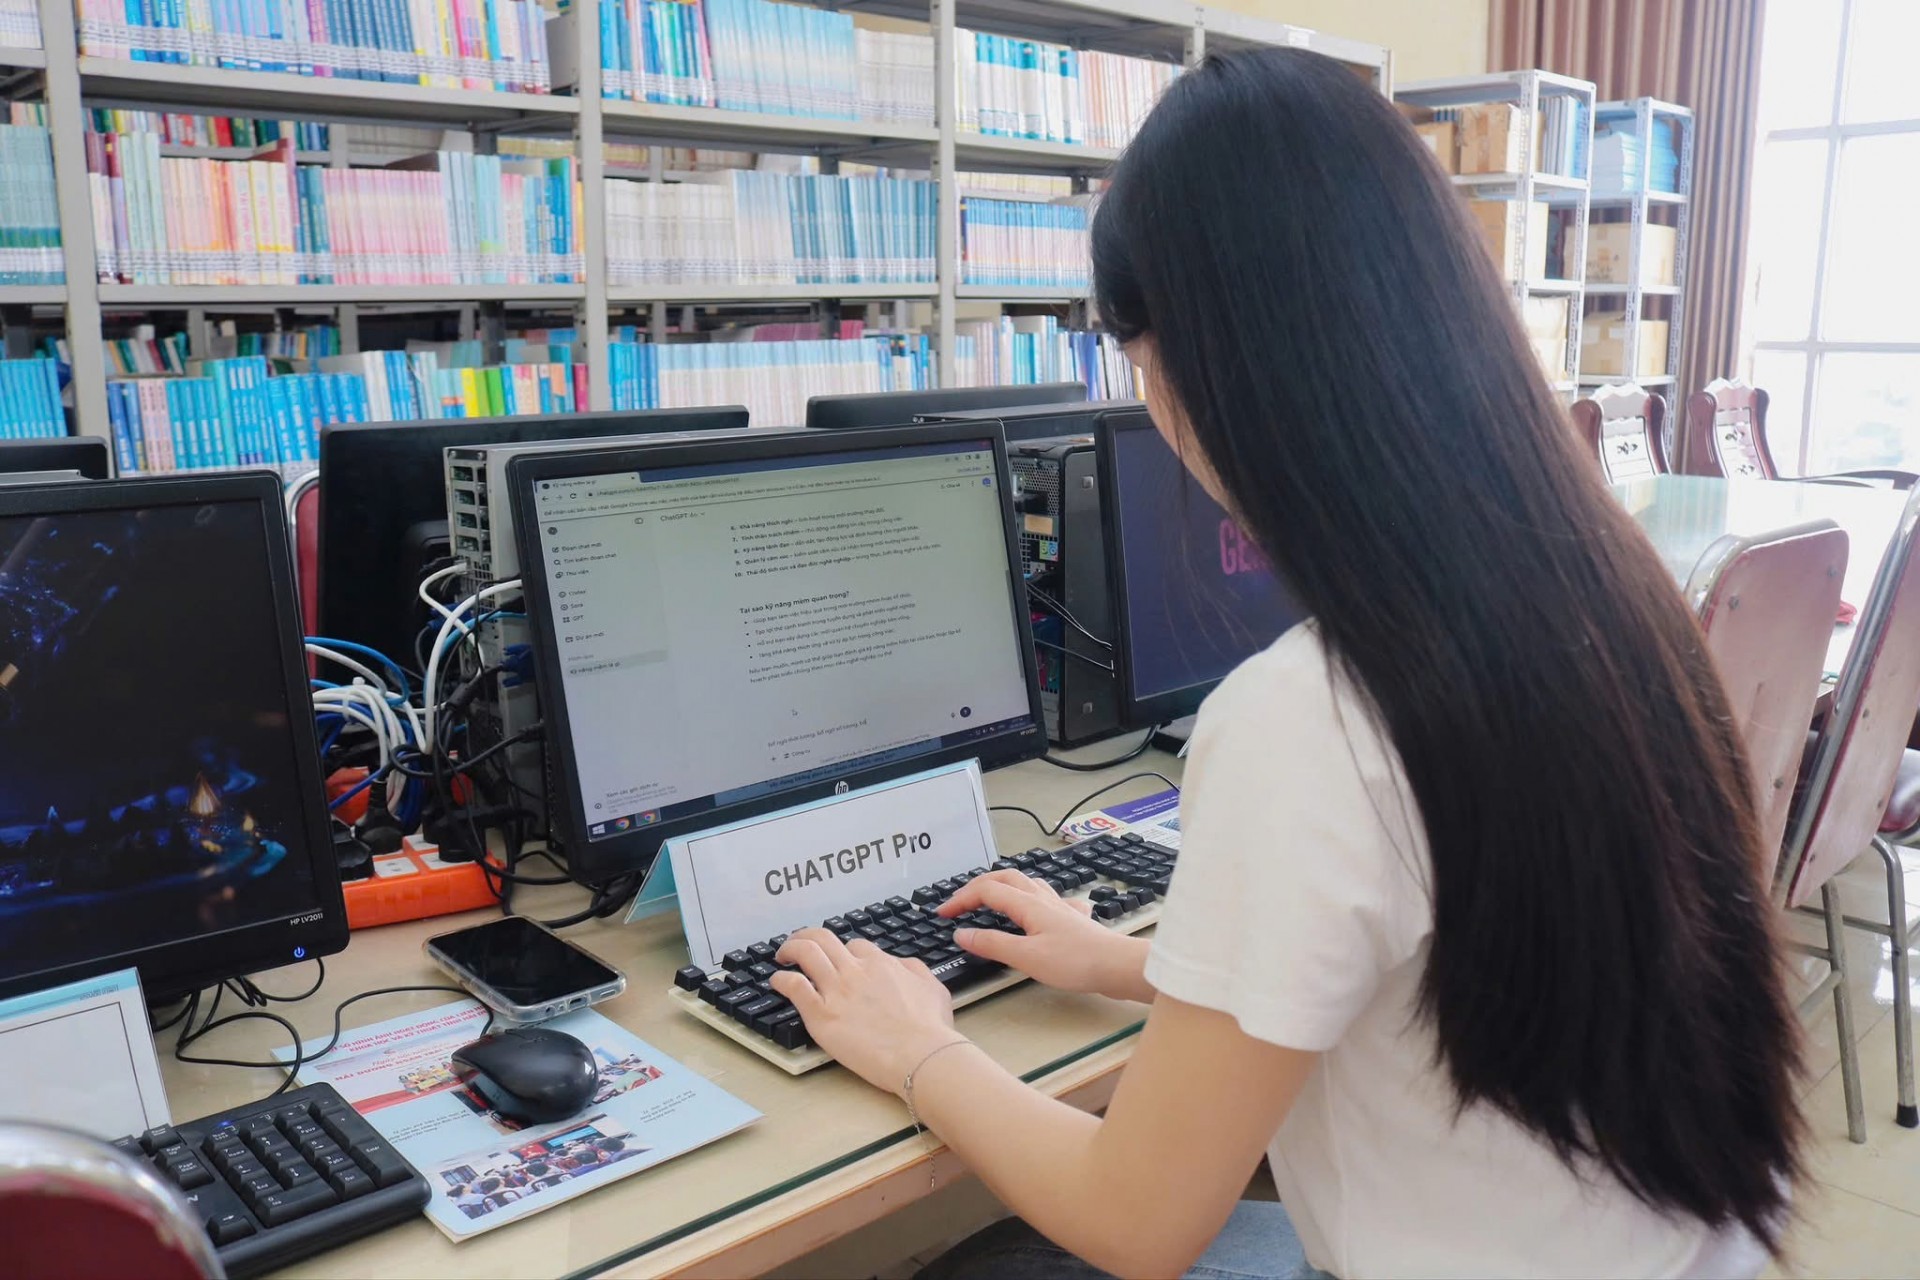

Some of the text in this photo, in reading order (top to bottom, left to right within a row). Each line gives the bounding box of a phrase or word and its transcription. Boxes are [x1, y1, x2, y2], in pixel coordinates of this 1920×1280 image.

[659, 512, 688, 521] ChatGPT
[764, 603, 774, 612] kỹ
[773, 600, 792, 610] năng
[810, 595, 828, 604] quan
[828, 590, 850, 601] trọng?
[765, 832, 931, 896] CHATGPT Pro
[301, 913, 323, 924] LV2011
[349, 1042, 373, 1053] KHOA
